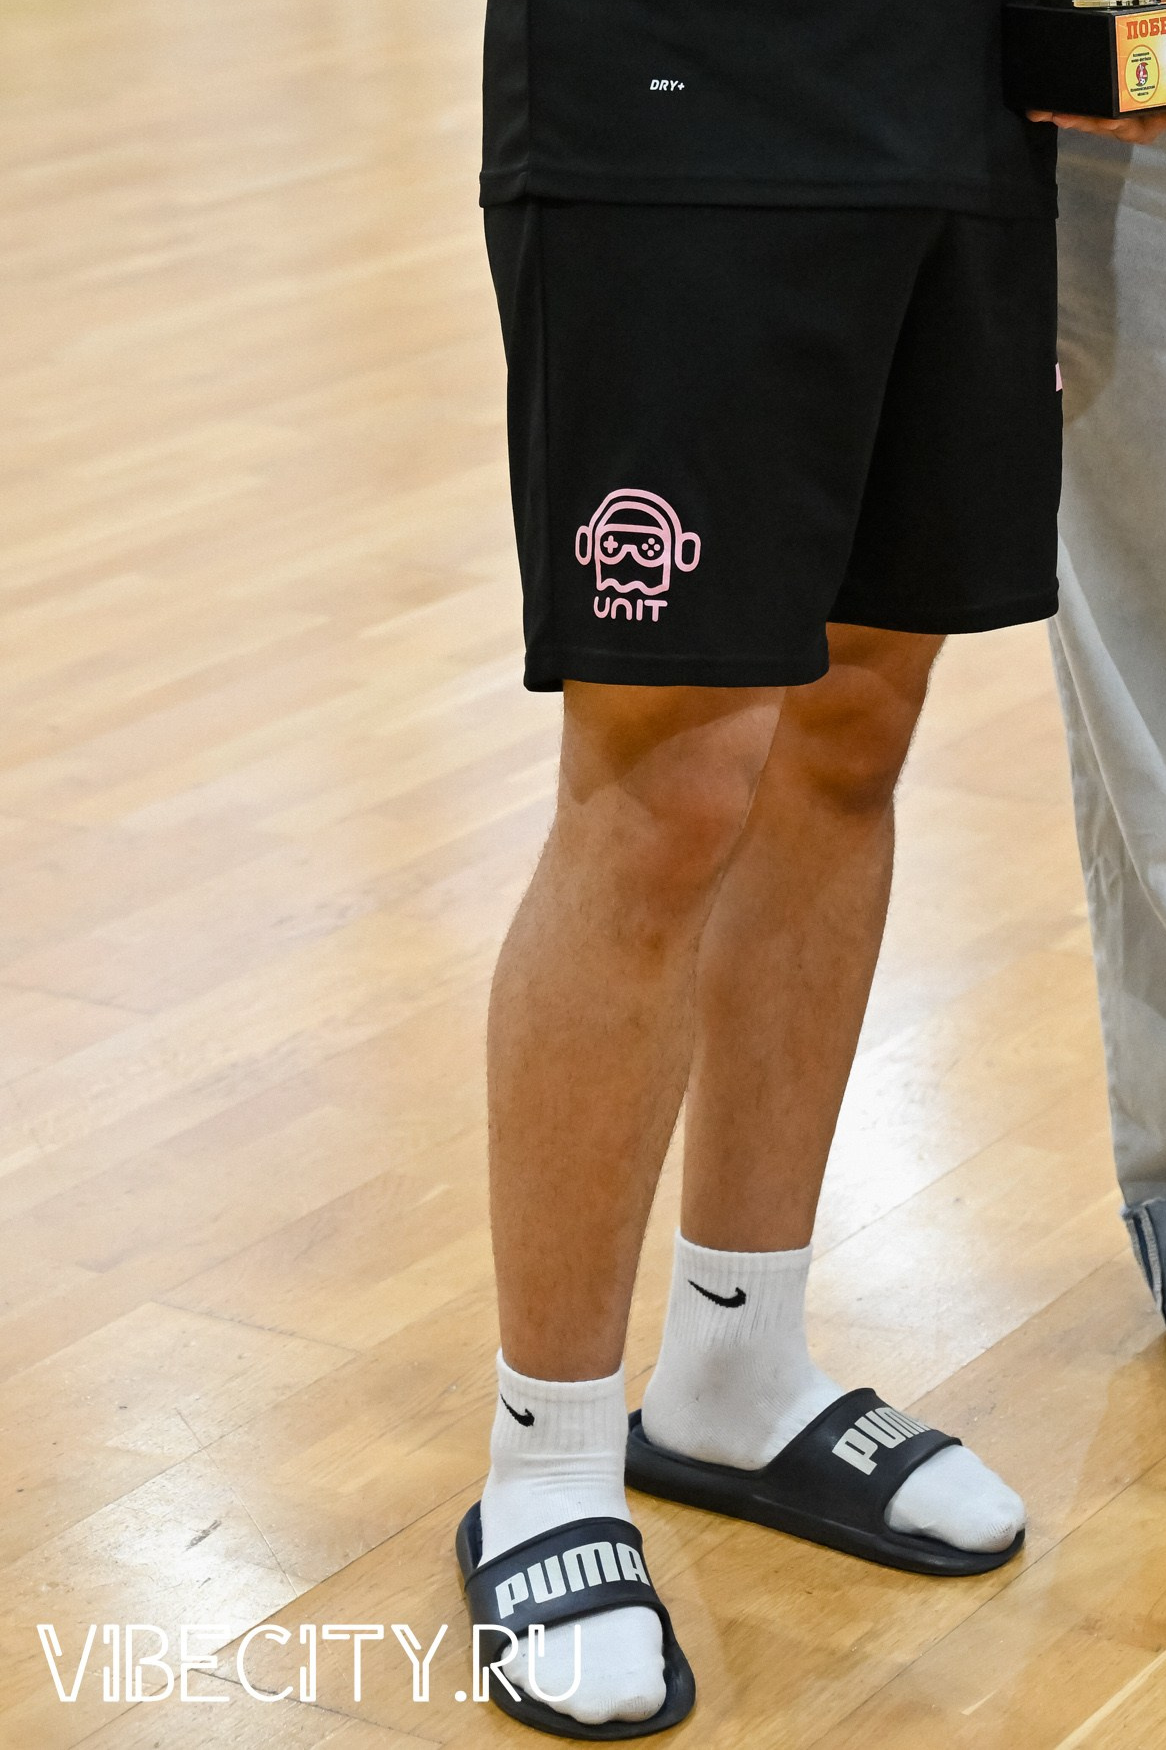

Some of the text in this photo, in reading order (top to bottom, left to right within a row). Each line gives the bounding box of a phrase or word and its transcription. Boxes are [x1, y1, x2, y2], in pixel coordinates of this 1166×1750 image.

[649, 79, 685, 91] DRY+
[593, 595, 669, 623] UNIT
[831, 1407, 932, 1476] PUM
[494, 1541, 651, 1620] PUMA
